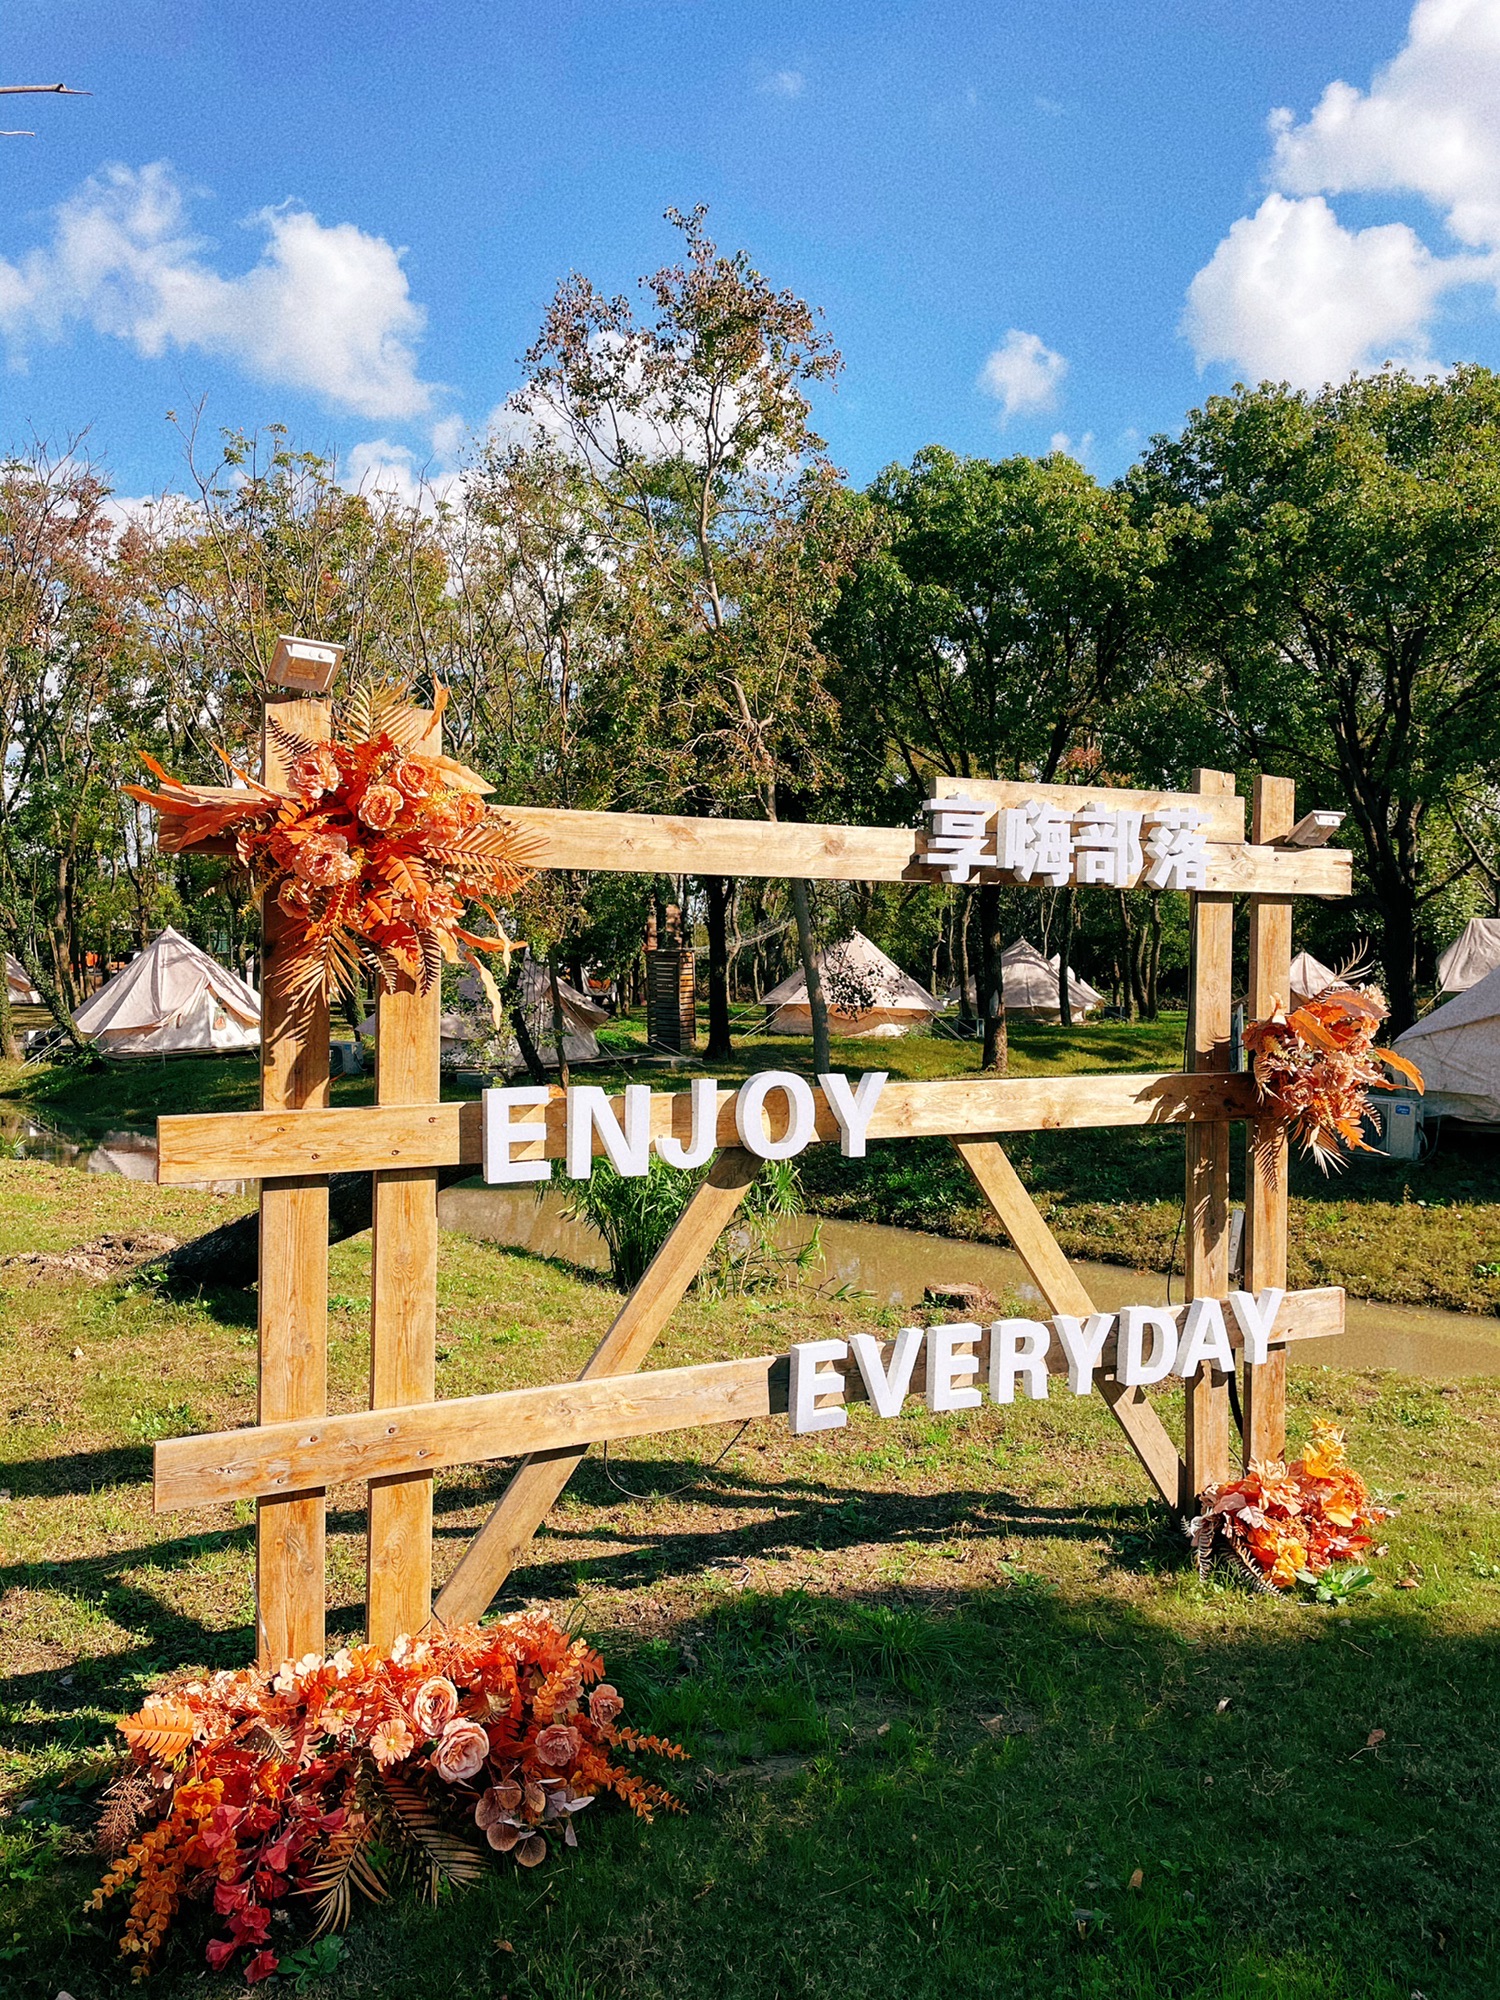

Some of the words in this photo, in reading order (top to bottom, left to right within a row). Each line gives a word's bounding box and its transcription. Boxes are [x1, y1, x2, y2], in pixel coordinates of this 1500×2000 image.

[919, 793, 1212, 890] 享嗨部落
[482, 1071, 888, 1184] ENJOY
[789, 1287, 1285, 1434] EVERYDAY
